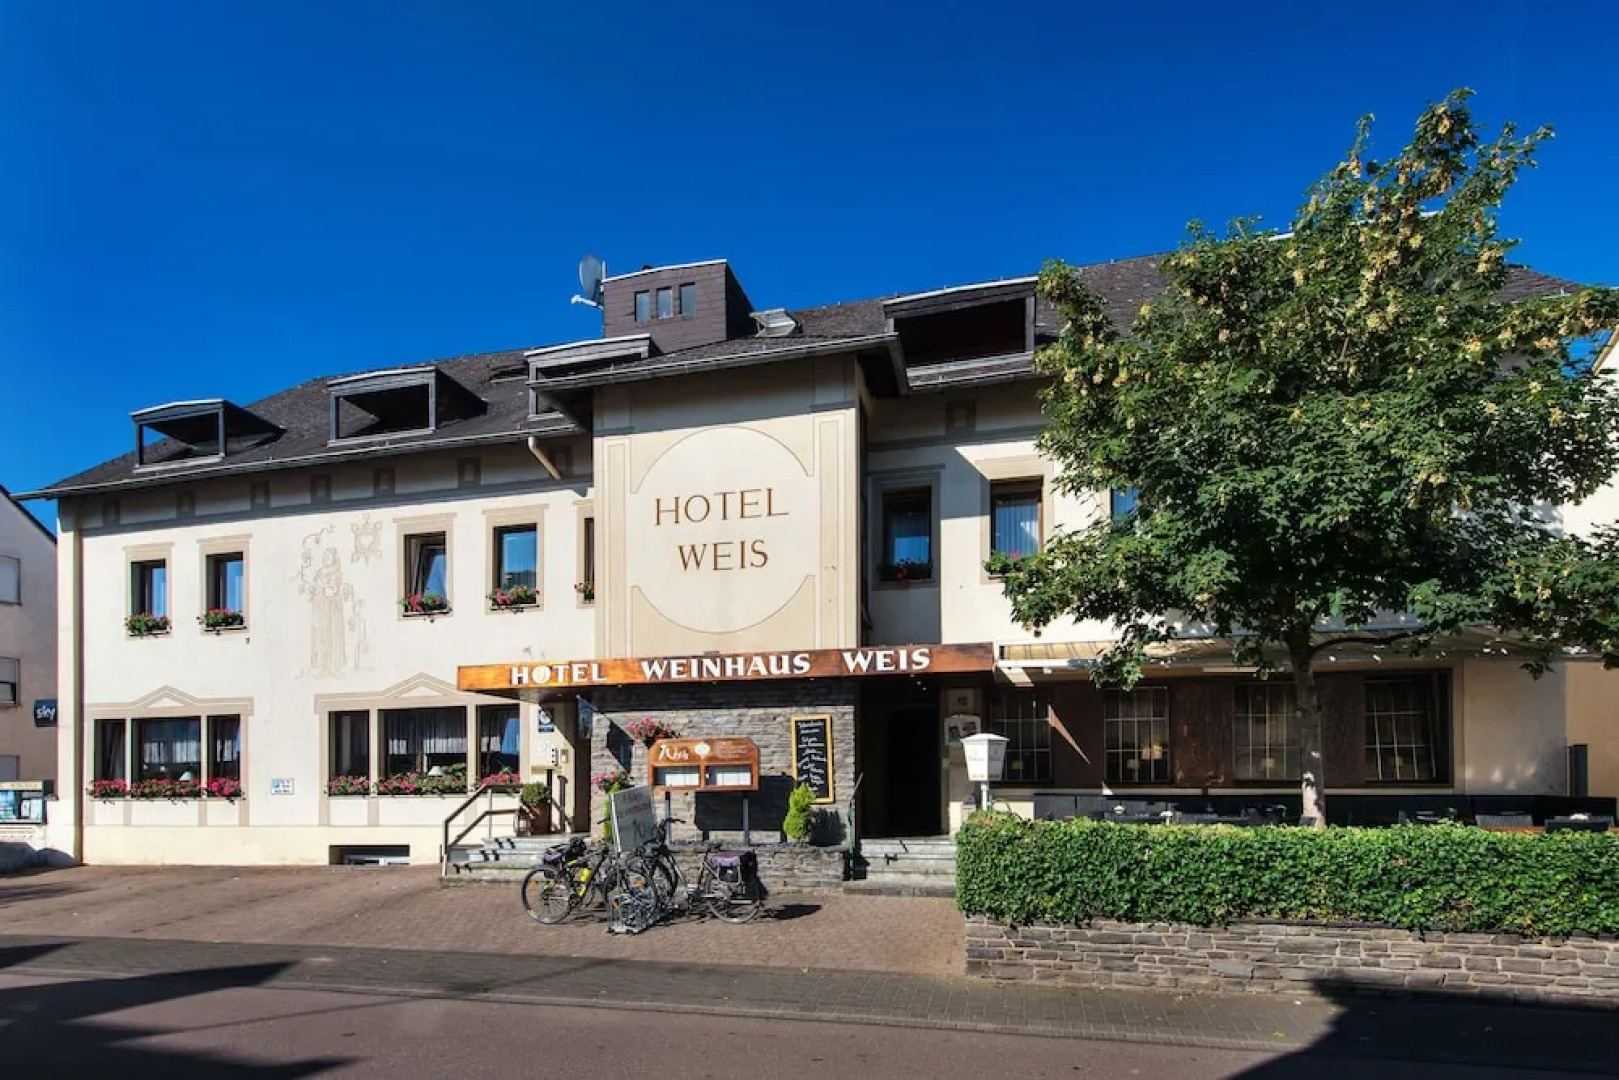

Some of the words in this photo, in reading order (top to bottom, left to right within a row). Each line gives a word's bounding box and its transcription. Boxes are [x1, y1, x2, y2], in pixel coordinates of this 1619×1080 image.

[655, 487, 790, 526] HOTEL
[678, 539, 769, 571] WEIS
[510, 663, 608, 686] HOTEL
[640, 652, 811, 683] WEINHAUS
[841, 647, 932, 673] WEIS
[36, 705, 56, 721] sky
